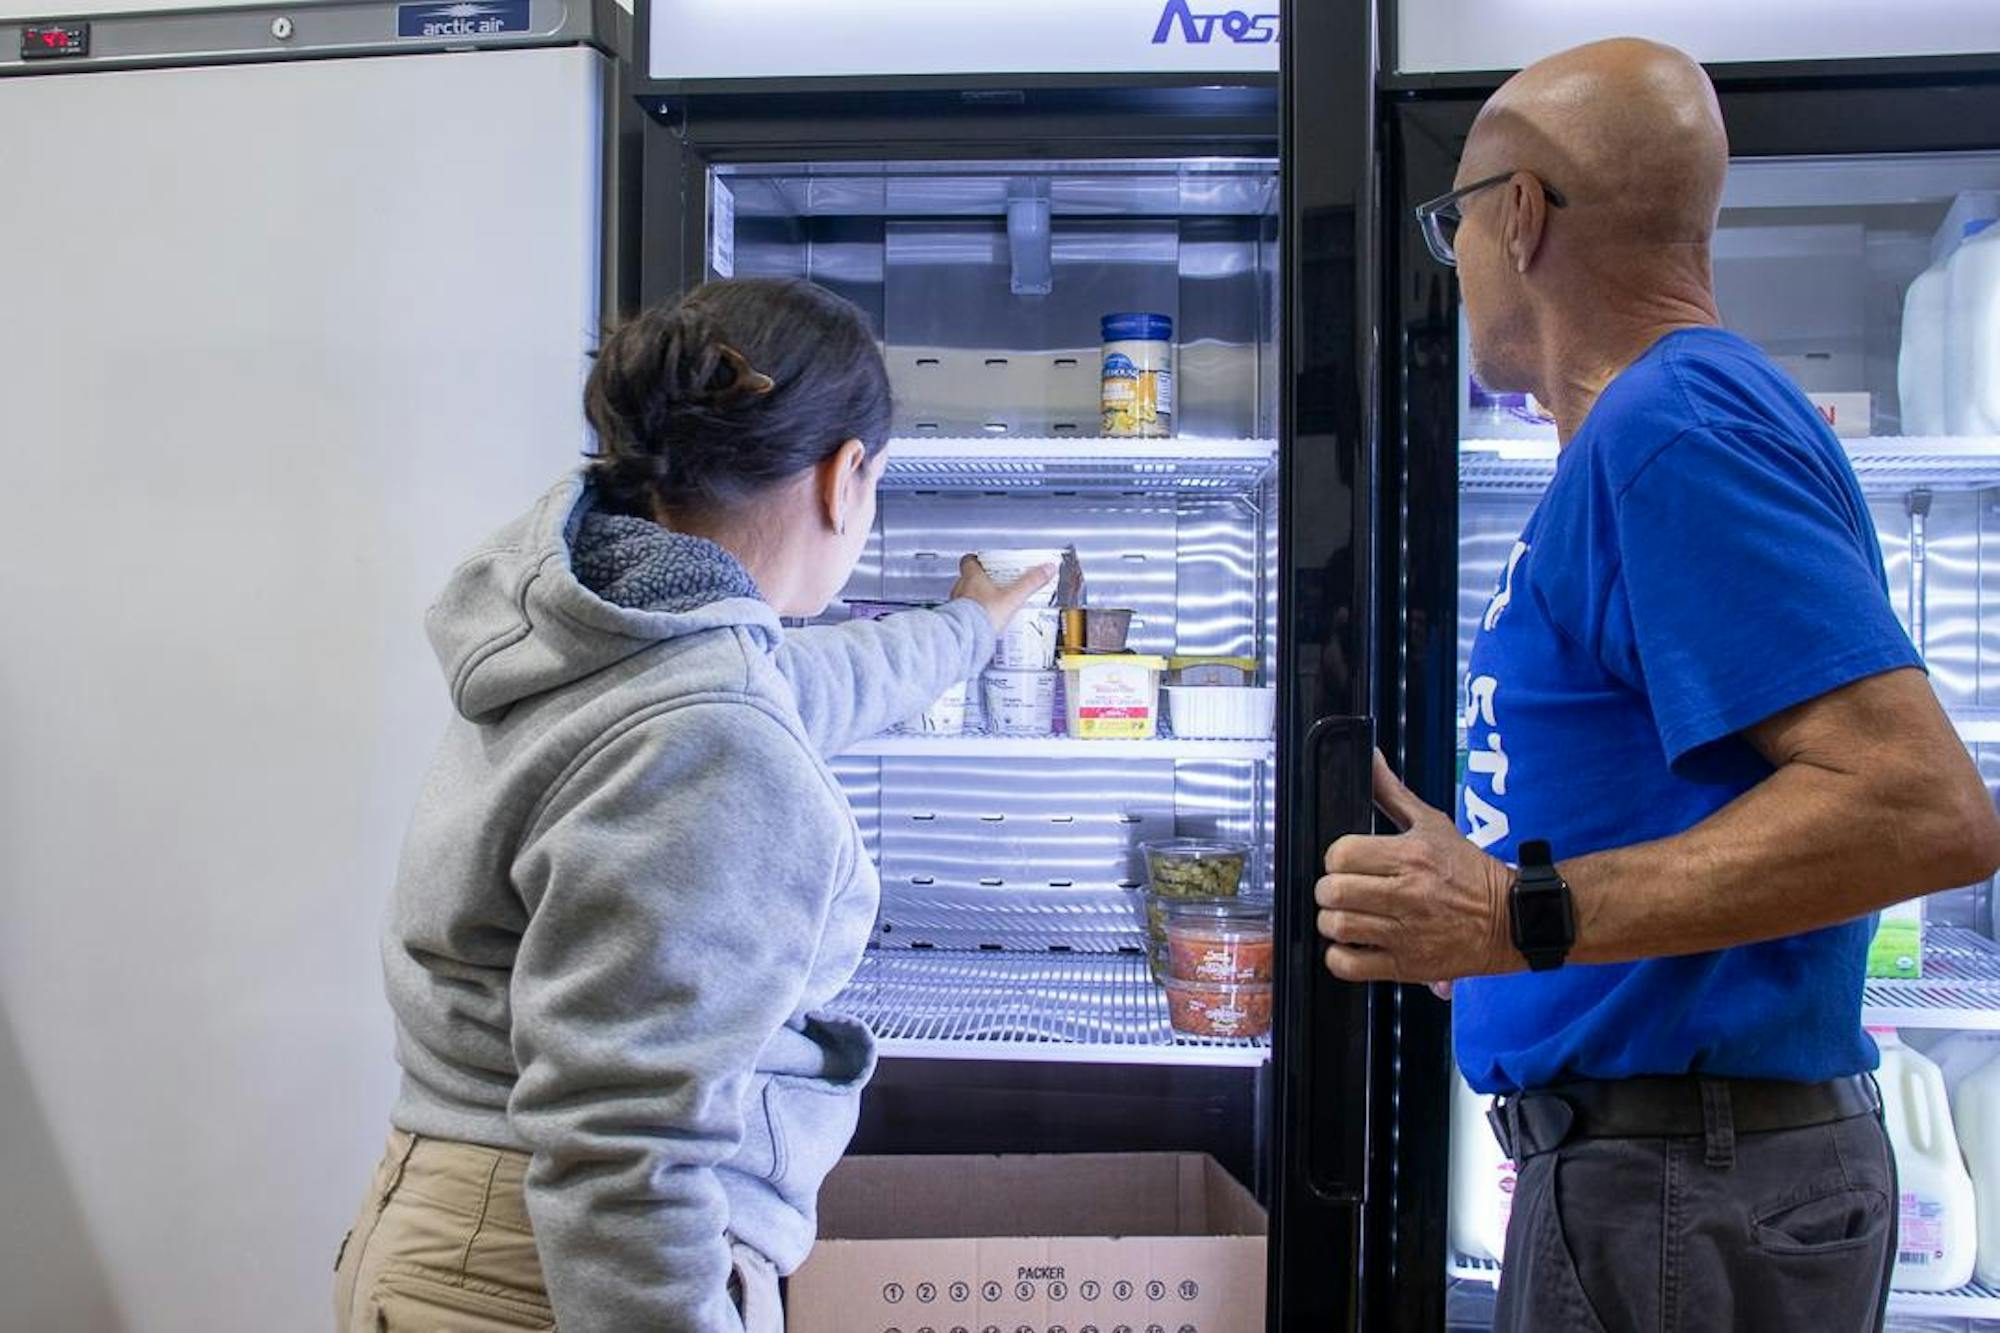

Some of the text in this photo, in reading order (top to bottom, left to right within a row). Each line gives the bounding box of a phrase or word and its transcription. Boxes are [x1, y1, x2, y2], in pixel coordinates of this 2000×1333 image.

[422, 17, 505, 36] arctic air
[1152, 0, 1280, 44] ATOS
[1463, 672, 1511, 850] STA
[1017, 1266, 1066, 1280] PACKER
